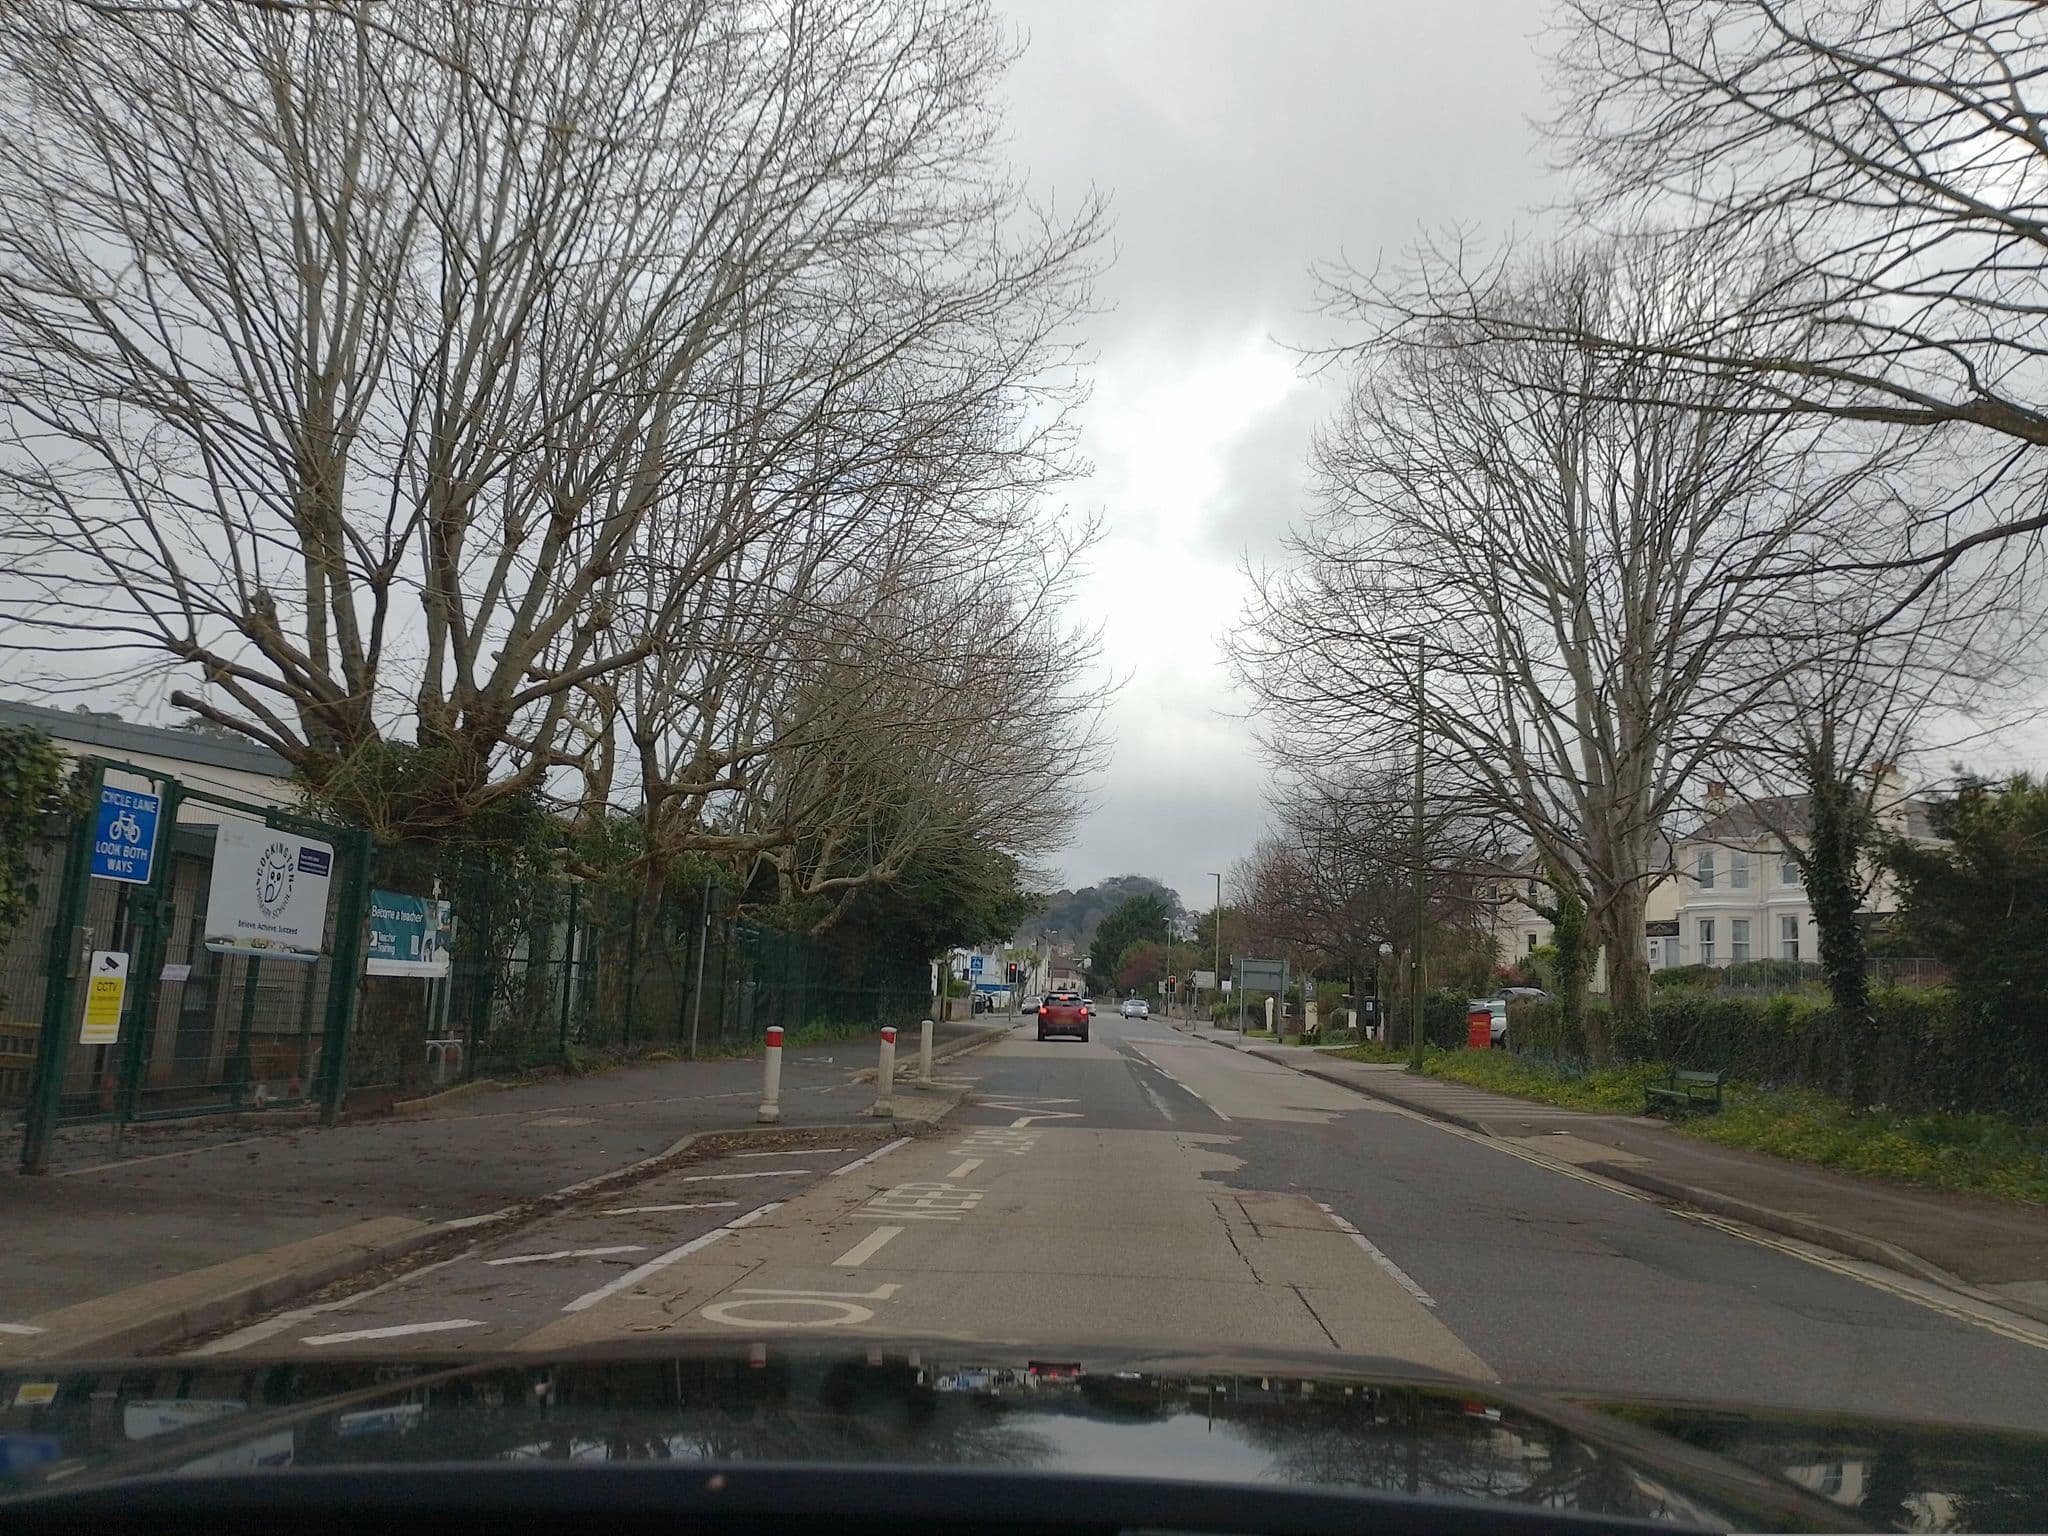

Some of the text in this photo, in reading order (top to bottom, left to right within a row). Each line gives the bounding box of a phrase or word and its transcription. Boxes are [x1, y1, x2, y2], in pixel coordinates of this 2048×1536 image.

[101, 790, 157, 813] CYCLE LANE
[95, 841, 149, 861] LOOK BOTH
[107, 858, 134, 873] WAYS
[257, 842, 295, 882] COCKINGTON
[371, 904, 395, 919] Become
[400, 911, 424, 923] teacher
[96, 981, 118, 992] CCTV
[849, 1181, 990, 1221] KEEP
